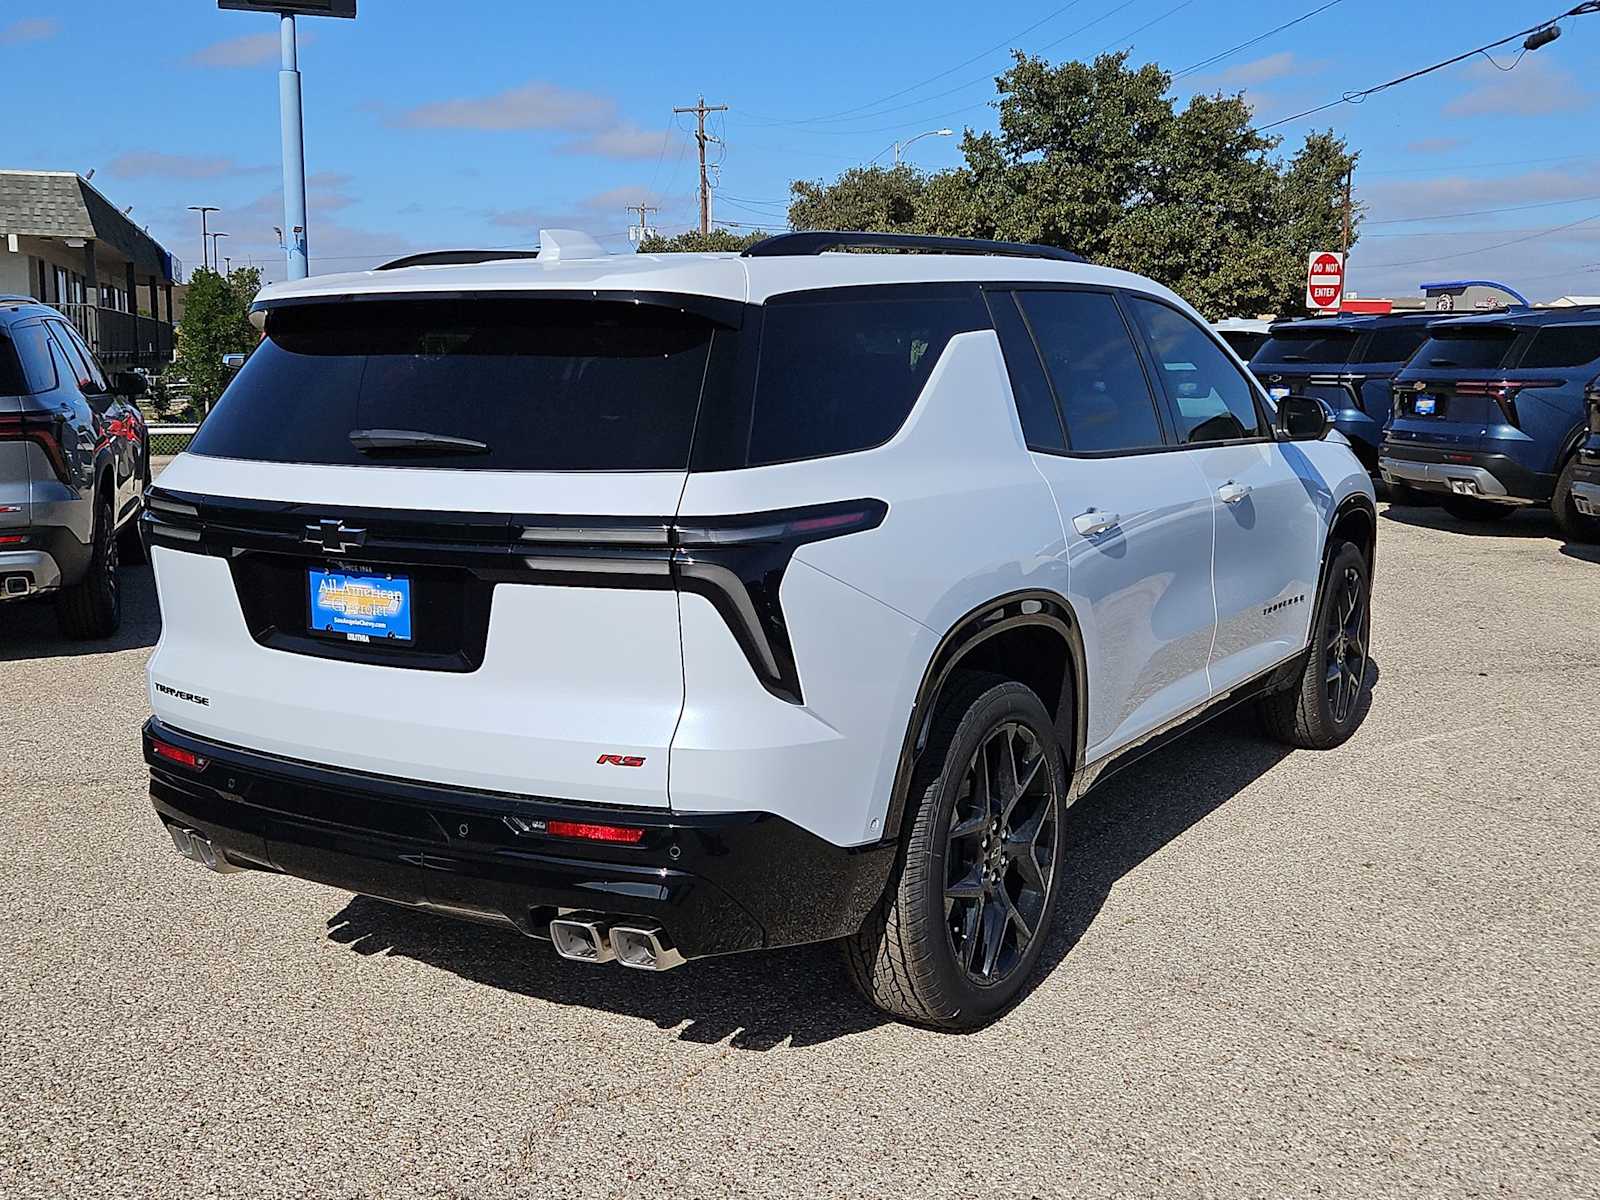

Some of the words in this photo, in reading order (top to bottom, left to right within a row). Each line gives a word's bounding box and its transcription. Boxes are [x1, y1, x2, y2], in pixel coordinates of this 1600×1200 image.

[1314, 263, 1323, 273] DO
[1325, 263, 1338, 273] NOT
[1314, 287, 1335, 297] ENTER
[318, 578, 336, 593] All
[341, 580, 402, 600] American
[1263, 594, 1305, 616] TRAVERSE
[154, 681, 210, 707] TRAVERSE
[596, 754, 646, 767] RS
